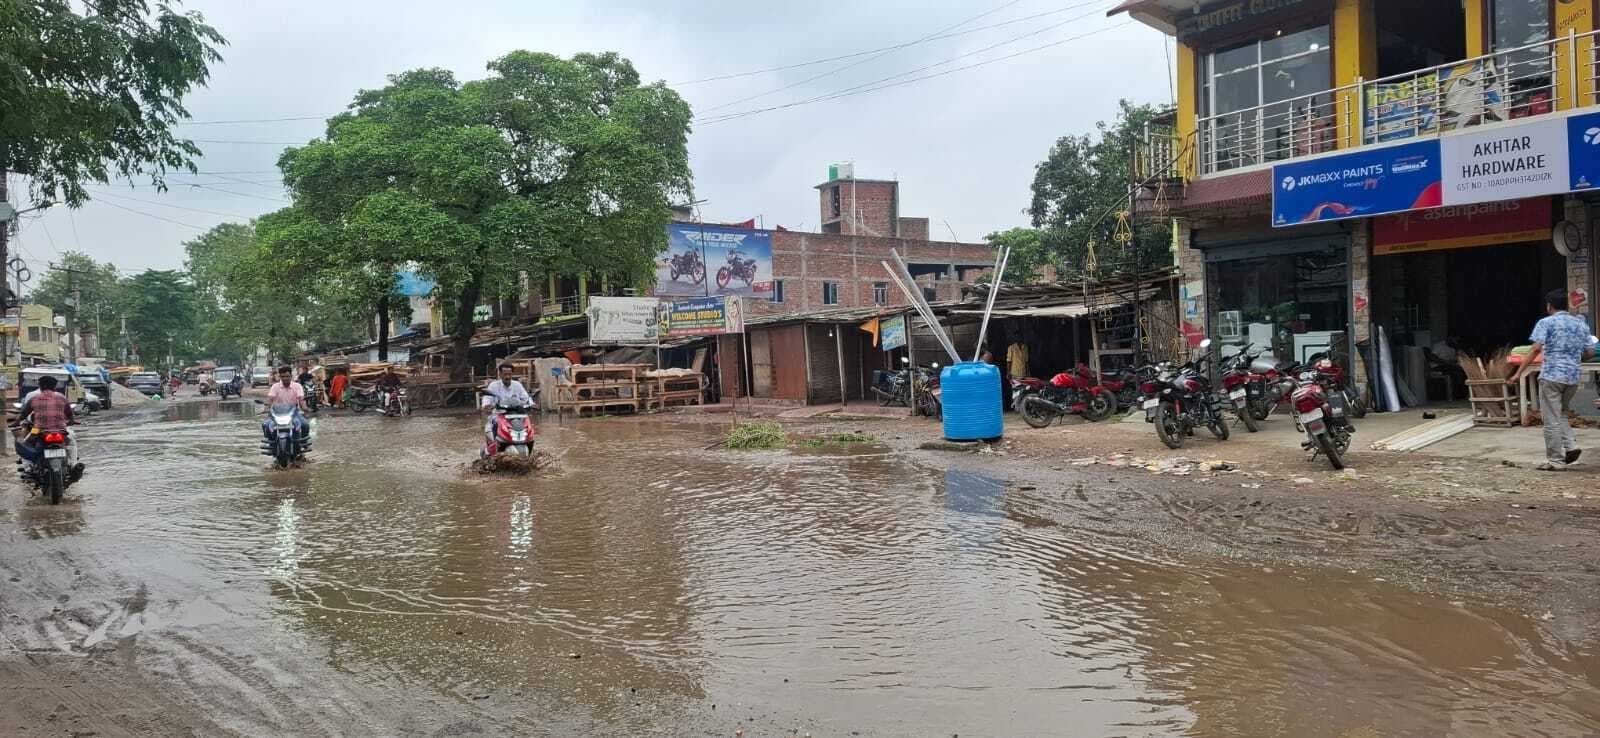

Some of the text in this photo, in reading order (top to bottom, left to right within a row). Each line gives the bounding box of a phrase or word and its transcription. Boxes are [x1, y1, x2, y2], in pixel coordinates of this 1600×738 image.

[1473, 135, 1531, 158] AKHTAR
[1343, 164, 1384, 179] PAINTS
[1462, 154, 1545, 179] HARDWARE
[1456, 181, 1469, 192] GST
[1423, 200, 1521, 222] asianpaints
